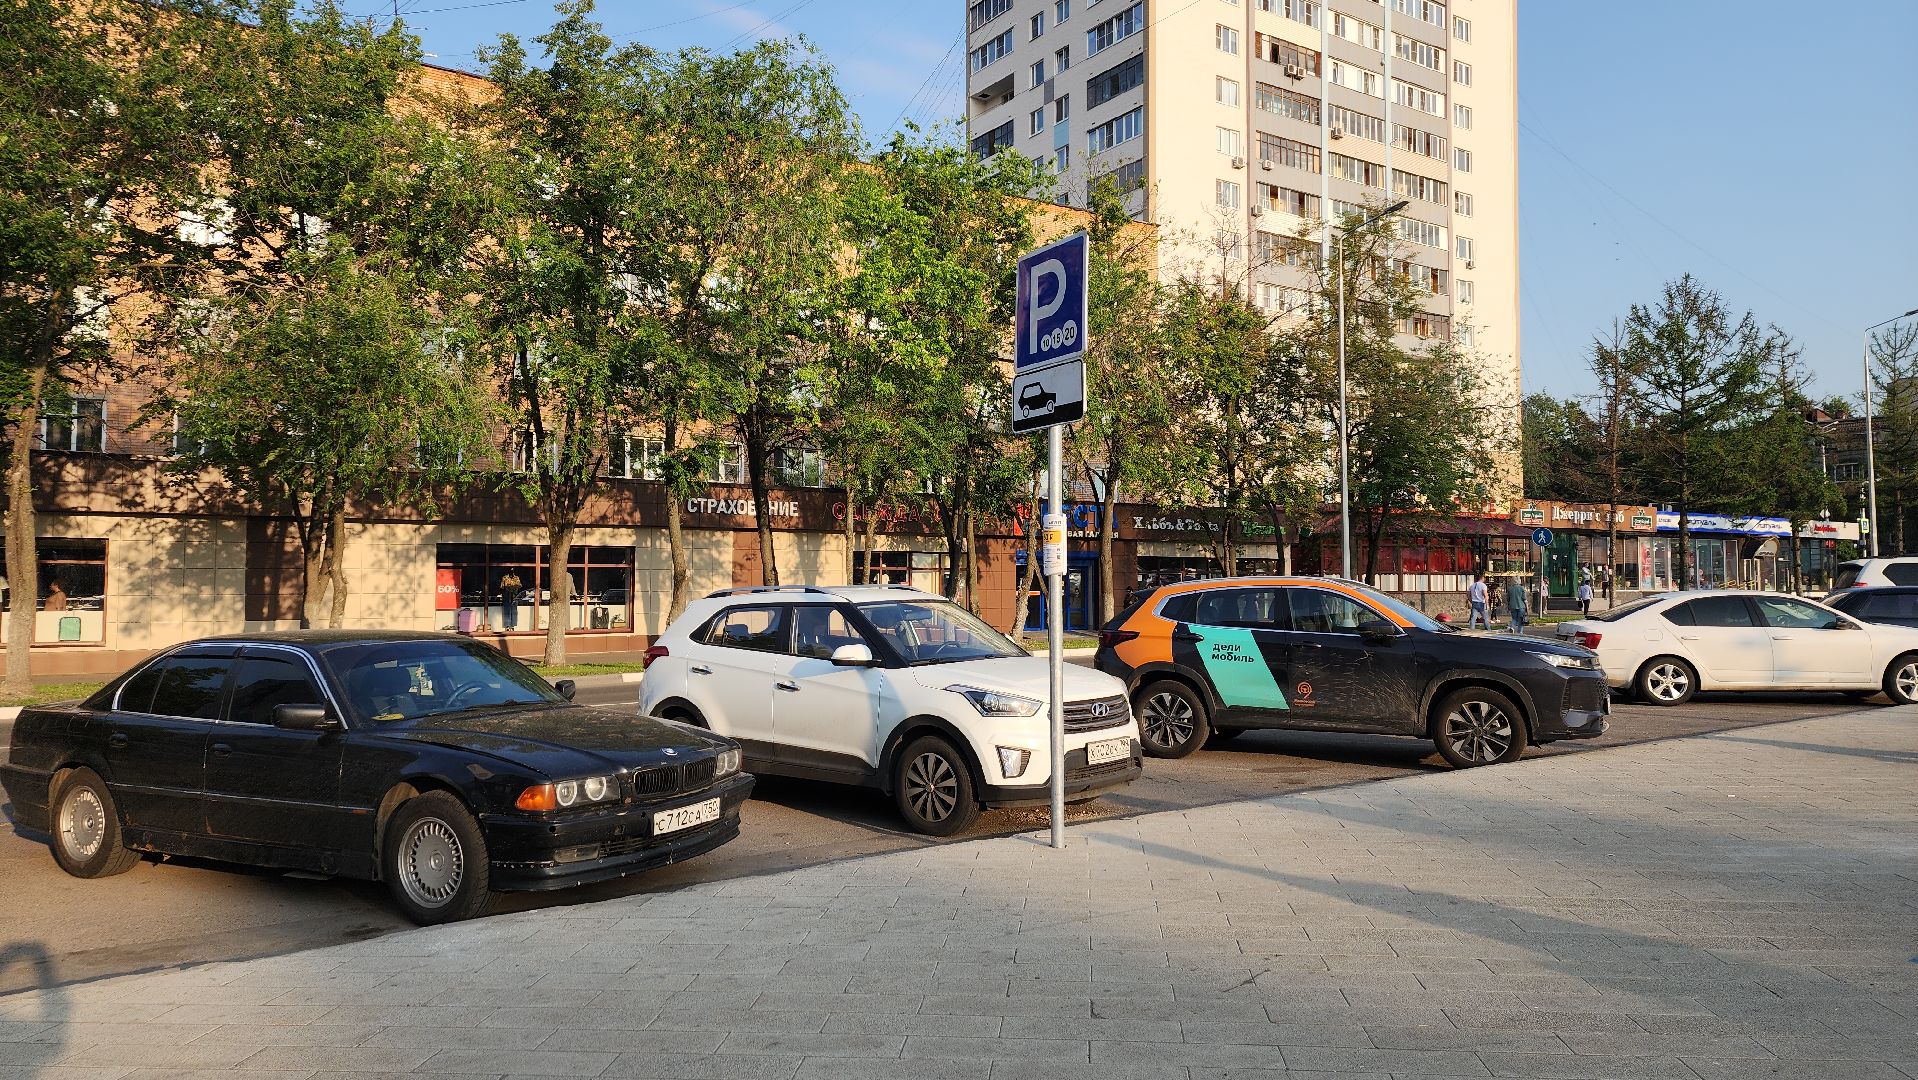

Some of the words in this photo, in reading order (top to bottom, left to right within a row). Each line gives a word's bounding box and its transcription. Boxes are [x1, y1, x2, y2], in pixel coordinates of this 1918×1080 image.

[1029, 258, 1067, 355] P
[1042, 338, 1050, 348] 10
[1053, 333, 1061, 345] 15
[1064, 326, 1075, 341] 20
[687, 497, 799, 516] СТРАХОВНИЕ
[1211, 652, 1255, 663] мобиль
[1212, 643, 1241, 653] дели
[657, 809, 701, 832] С712СА
[703, 800, 717, 814] 750
